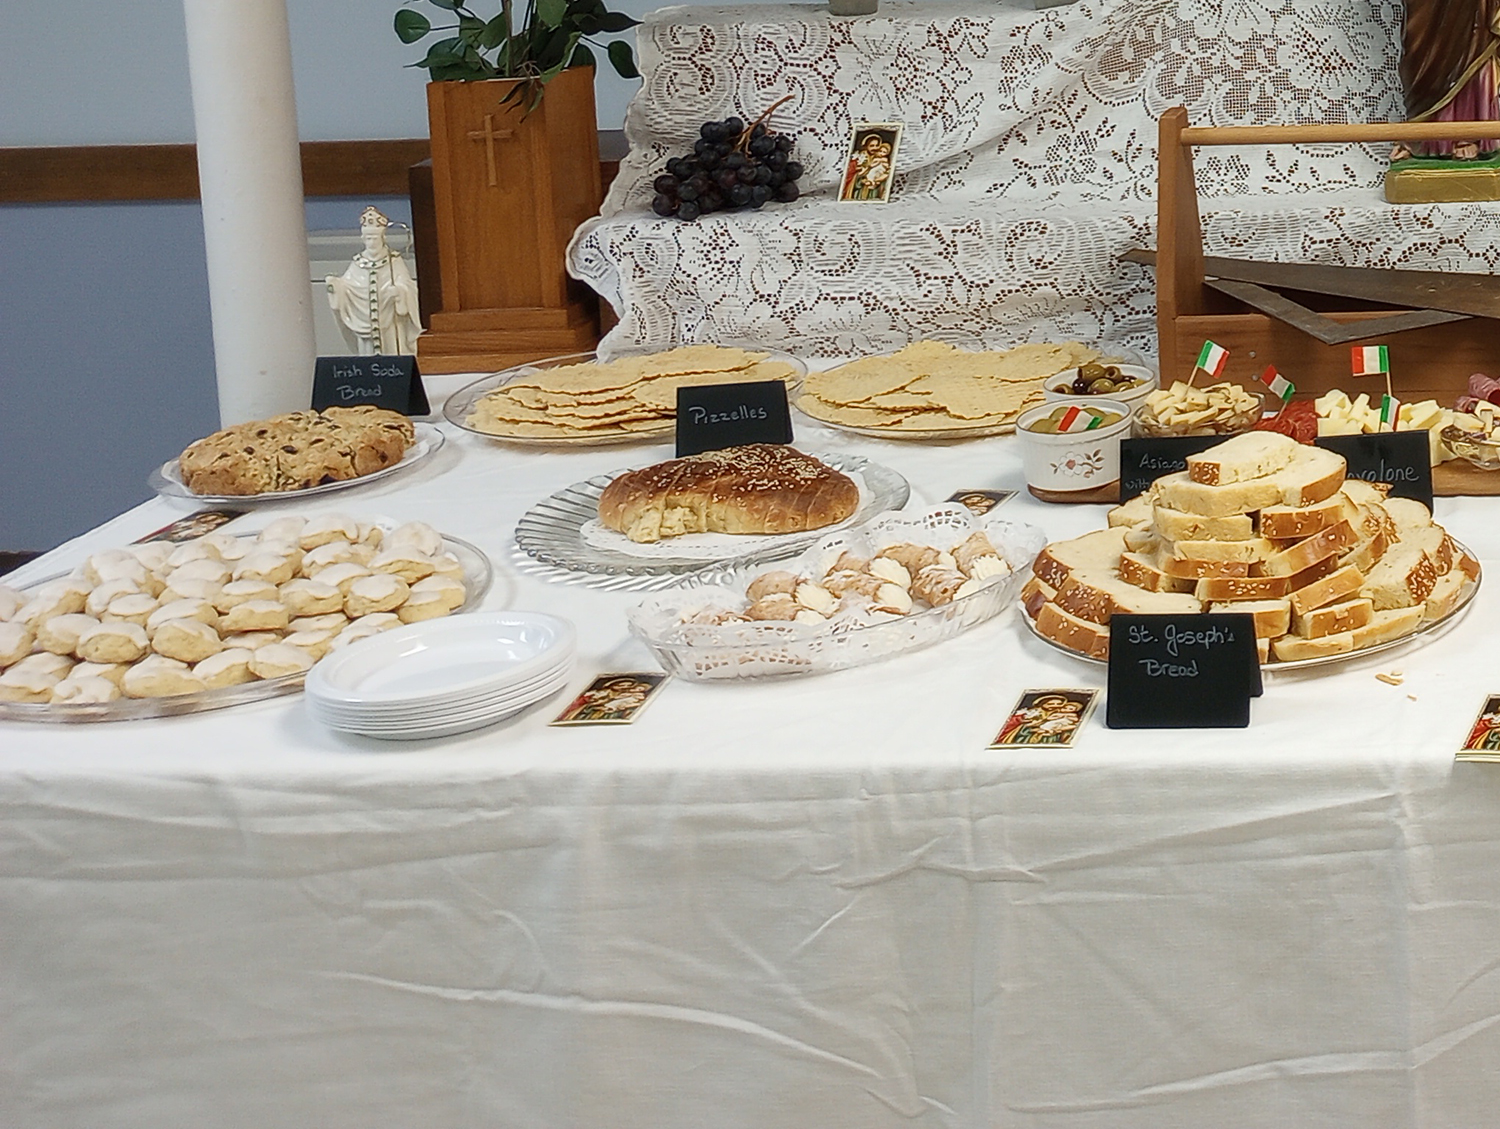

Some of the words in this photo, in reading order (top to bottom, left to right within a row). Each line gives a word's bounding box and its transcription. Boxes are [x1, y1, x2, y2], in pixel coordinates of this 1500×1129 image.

[333, 365, 362, 378] Irish
[371, 363, 404, 376] Soda
[336, 385, 382, 400] Bread
[689, 405, 767, 424] Pizzelles
[1129, 625, 1158, 643] St.
[1165, 624, 1235, 656] Joseph's
[1138, 659, 1199, 677] Bread
